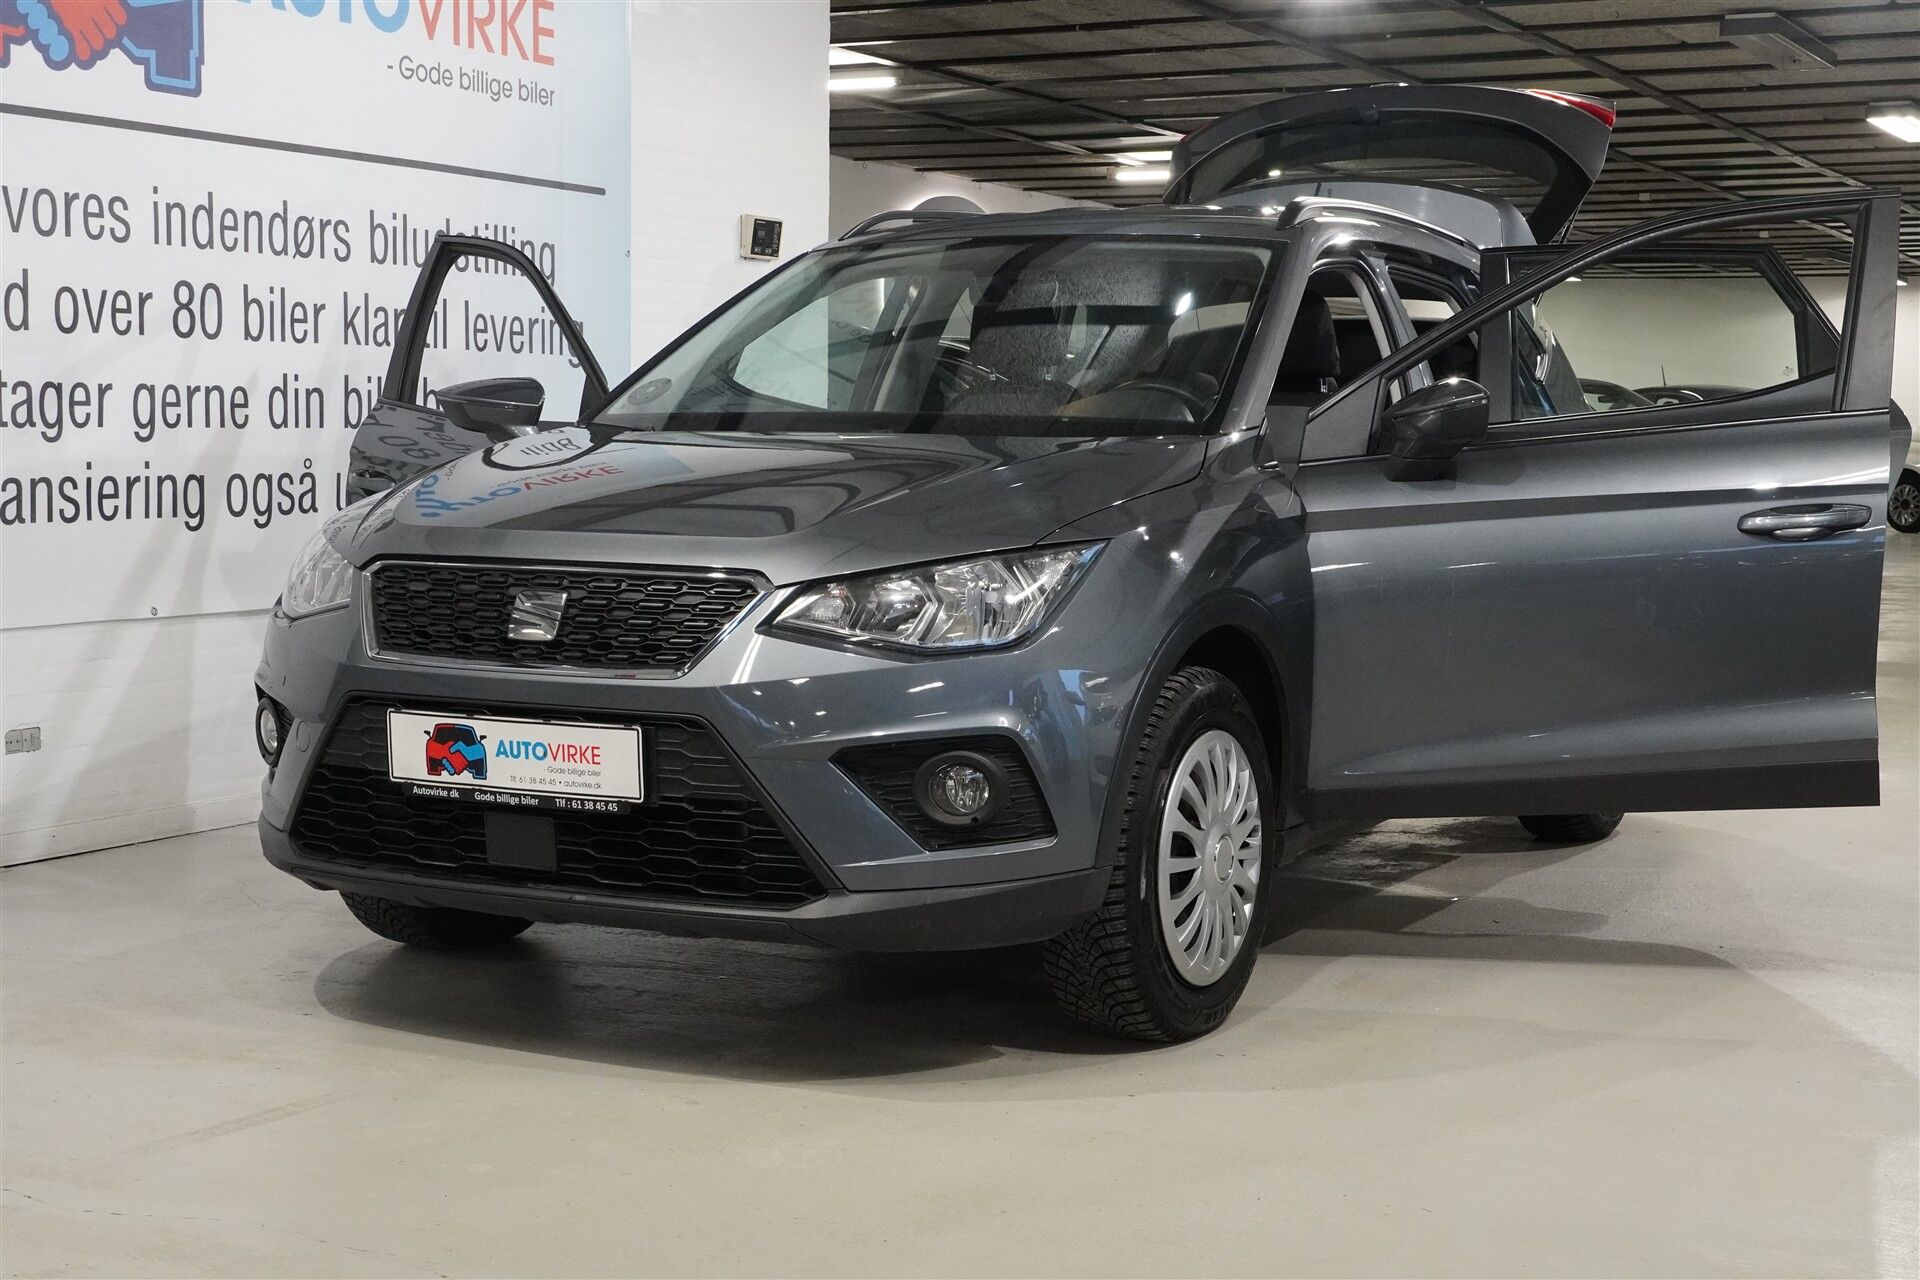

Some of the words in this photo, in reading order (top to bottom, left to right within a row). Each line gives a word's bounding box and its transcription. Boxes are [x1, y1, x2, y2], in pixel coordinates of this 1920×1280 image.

[399, 55, 453, 87] Gode
[459, 66, 513, 102] billige
[518, 78, 555, 106] biler
[1, 185, 131, 243] vores
[152, 185, 351, 263] indendørs
[54, 286, 153, 335] over
[172, 280, 223, 340] 80
[243, 284, 326, 344] biler
[343, 291, 407, 349] klar
[424, 298, 448, 350] il
[132, 382, 249, 443] gerne
[268, 373, 325, 429] din
[0, 461, 205, 532] ansiering
[226, 457, 319, 529] også
[495, 739, 601, 766] AUTOVIRKE
[546, 766, 566, 774] Gode
[567, 768, 587, 777] billige
[587, 769, 601, 777] biler
[412, 785, 448, 797] Autovirke
[449, 789, 460, 798] dk
[474, 791, 495, 802] Gode
[496, 792, 520, 805] billige
[521, 796, 540, 806] biler
[572, 800, 582, 809] 61
[583, 801, 594, 810] 38
[595, 802, 606, 811] 45
[607, 803, 618, 812] 45
[548, 778, 557, 786] 45
